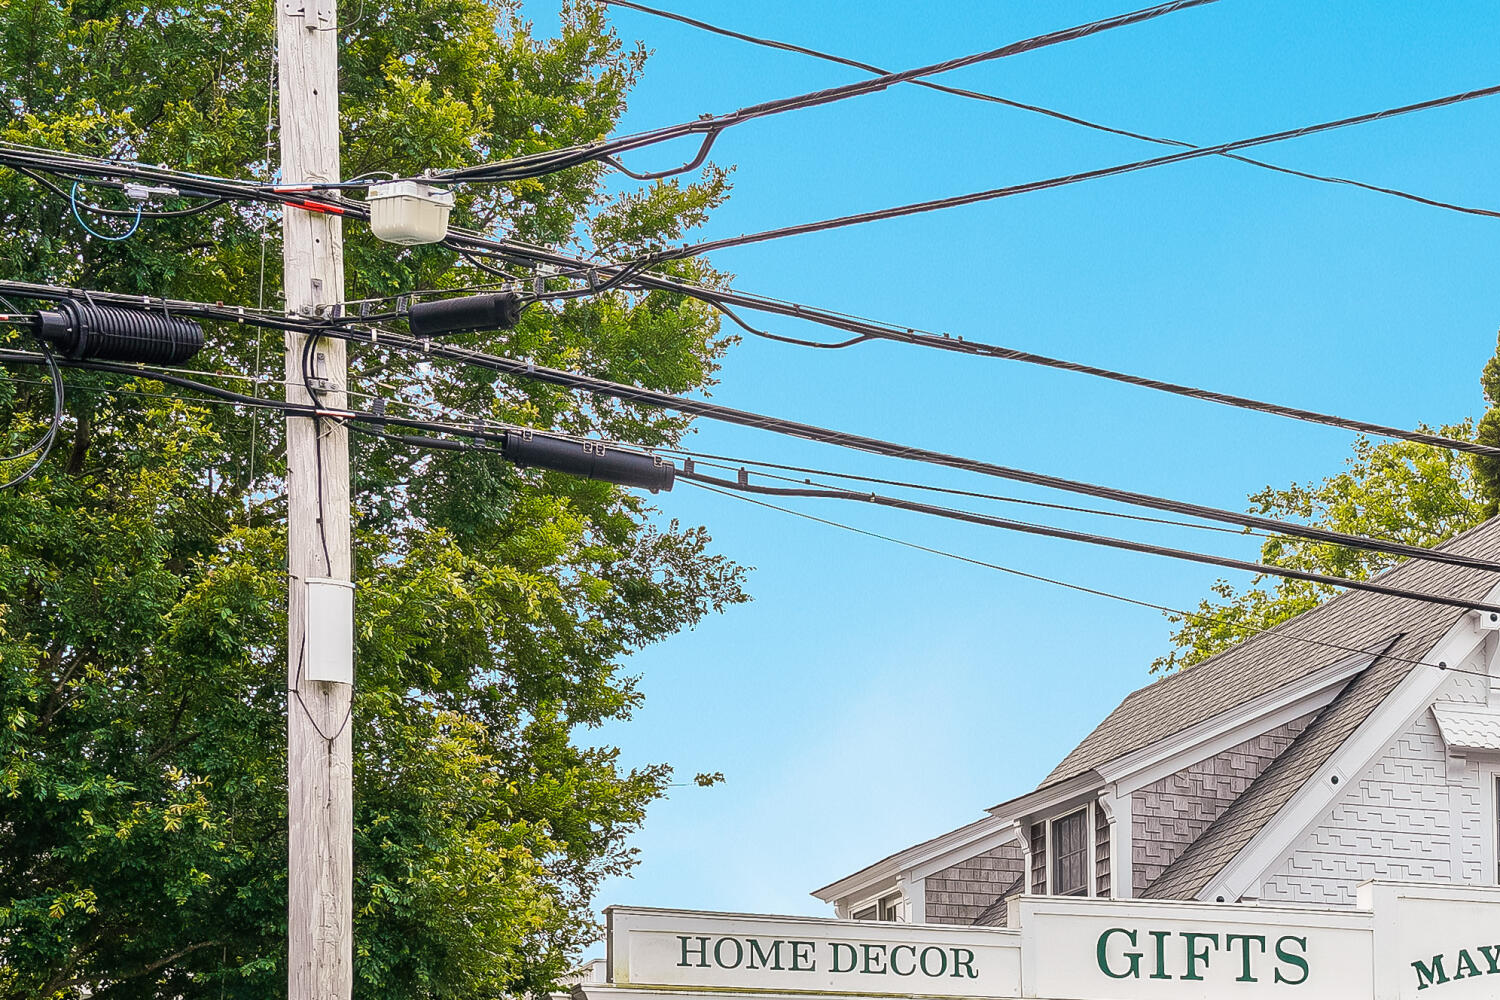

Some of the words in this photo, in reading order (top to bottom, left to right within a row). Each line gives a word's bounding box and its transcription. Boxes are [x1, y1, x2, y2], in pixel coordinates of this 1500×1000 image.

[676, 935, 816, 972] HOME
[828, 942, 979, 979] DECOR
[1096, 928, 1309, 985] GIFTS
